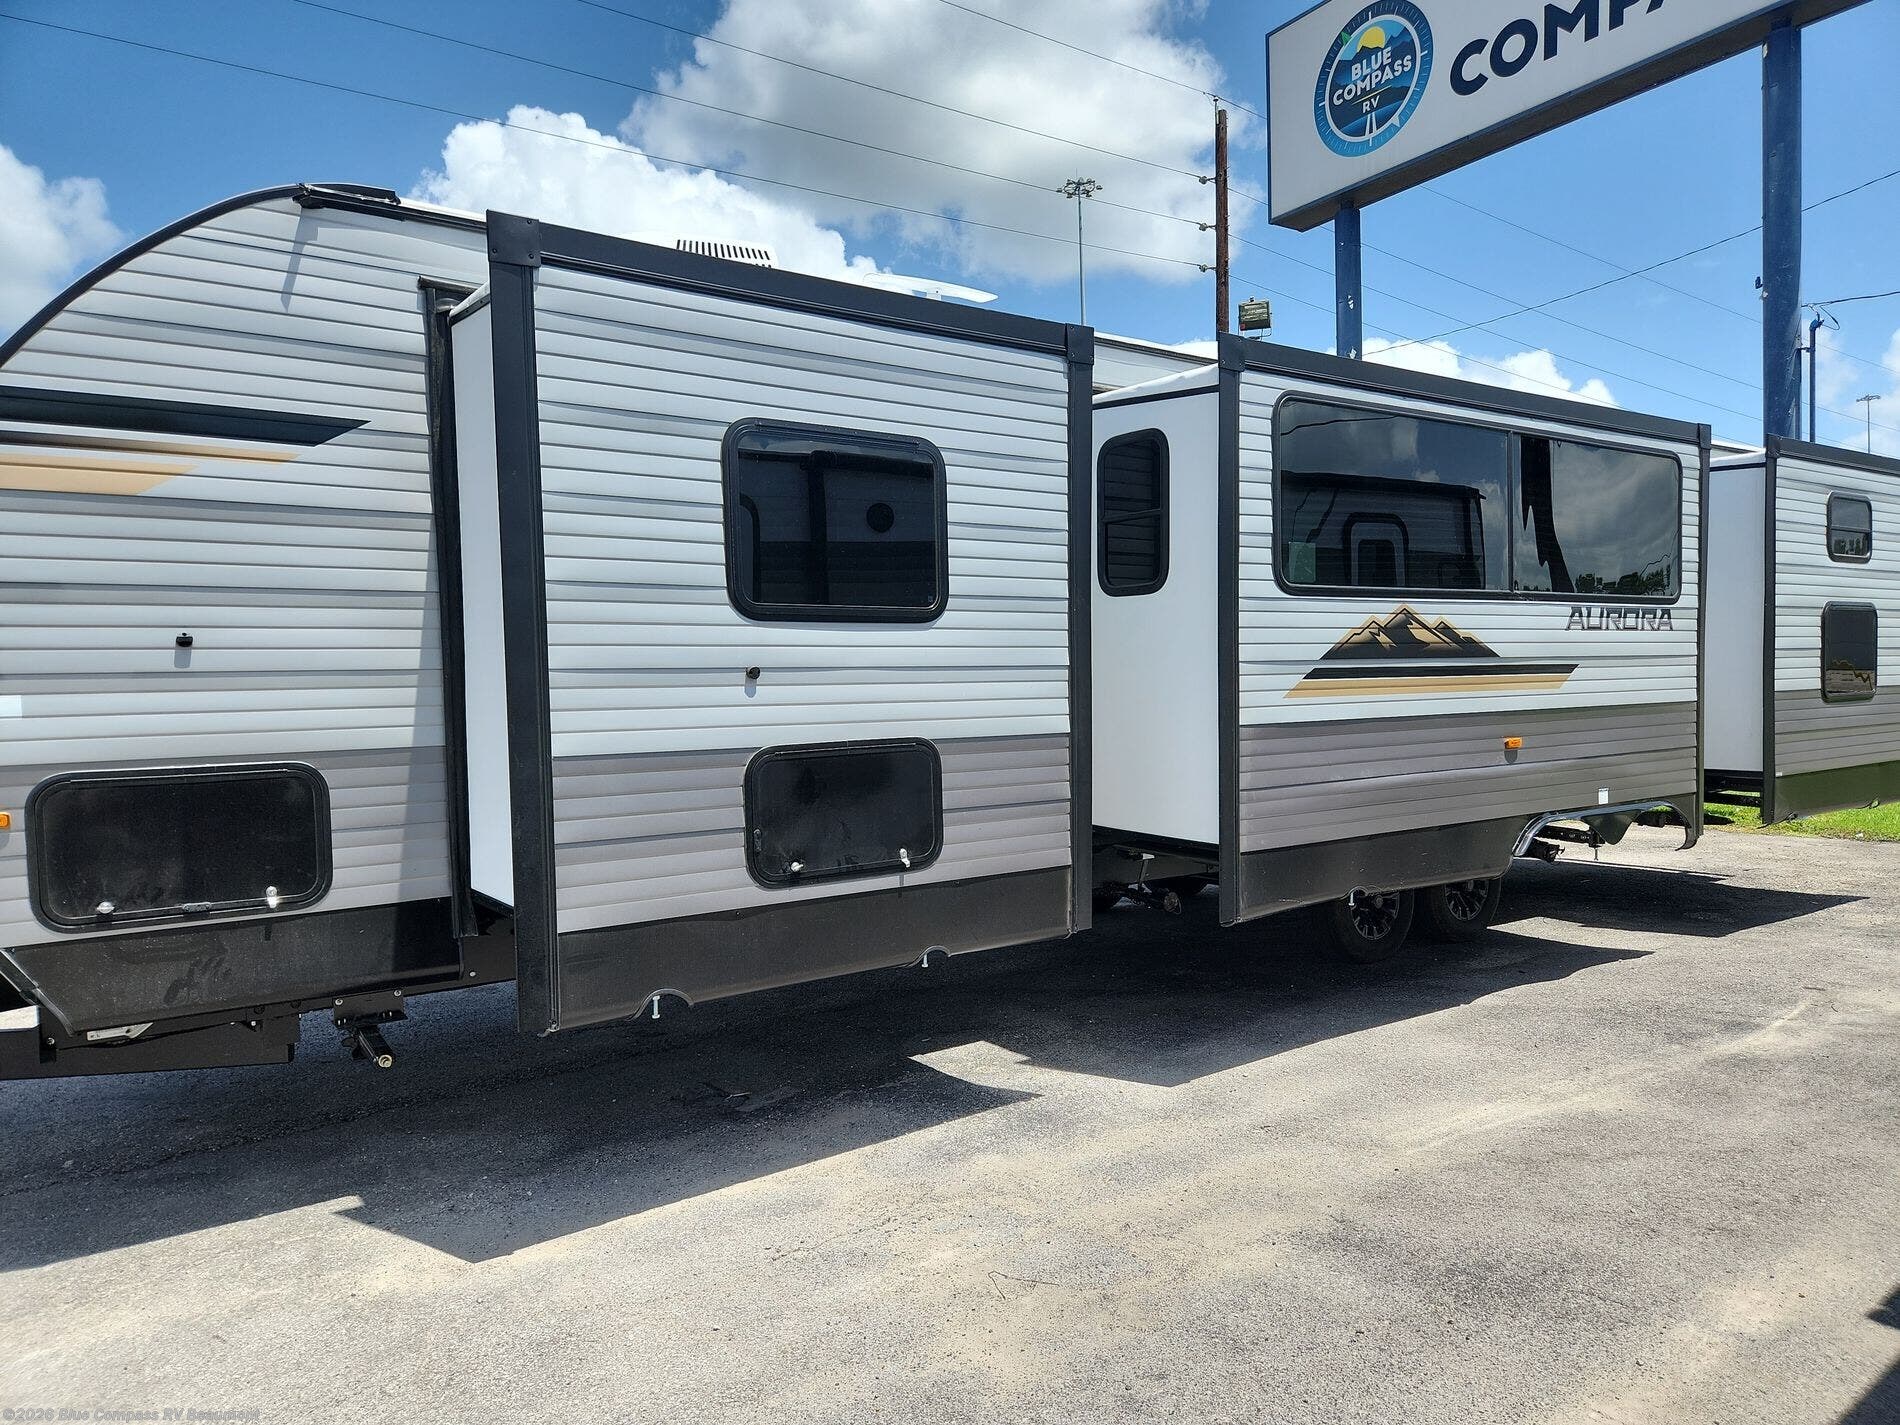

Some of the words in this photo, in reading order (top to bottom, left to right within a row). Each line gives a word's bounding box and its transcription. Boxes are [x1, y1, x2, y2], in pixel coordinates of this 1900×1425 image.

[1352, 47, 1392, 80] BLUE
[1450, 0, 1664, 96] COMP
[1333, 55, 1412, 105] COMPASS
[1362, 95, 1380, 113] RV
[1565, 606, 1674, 631] AURORA
